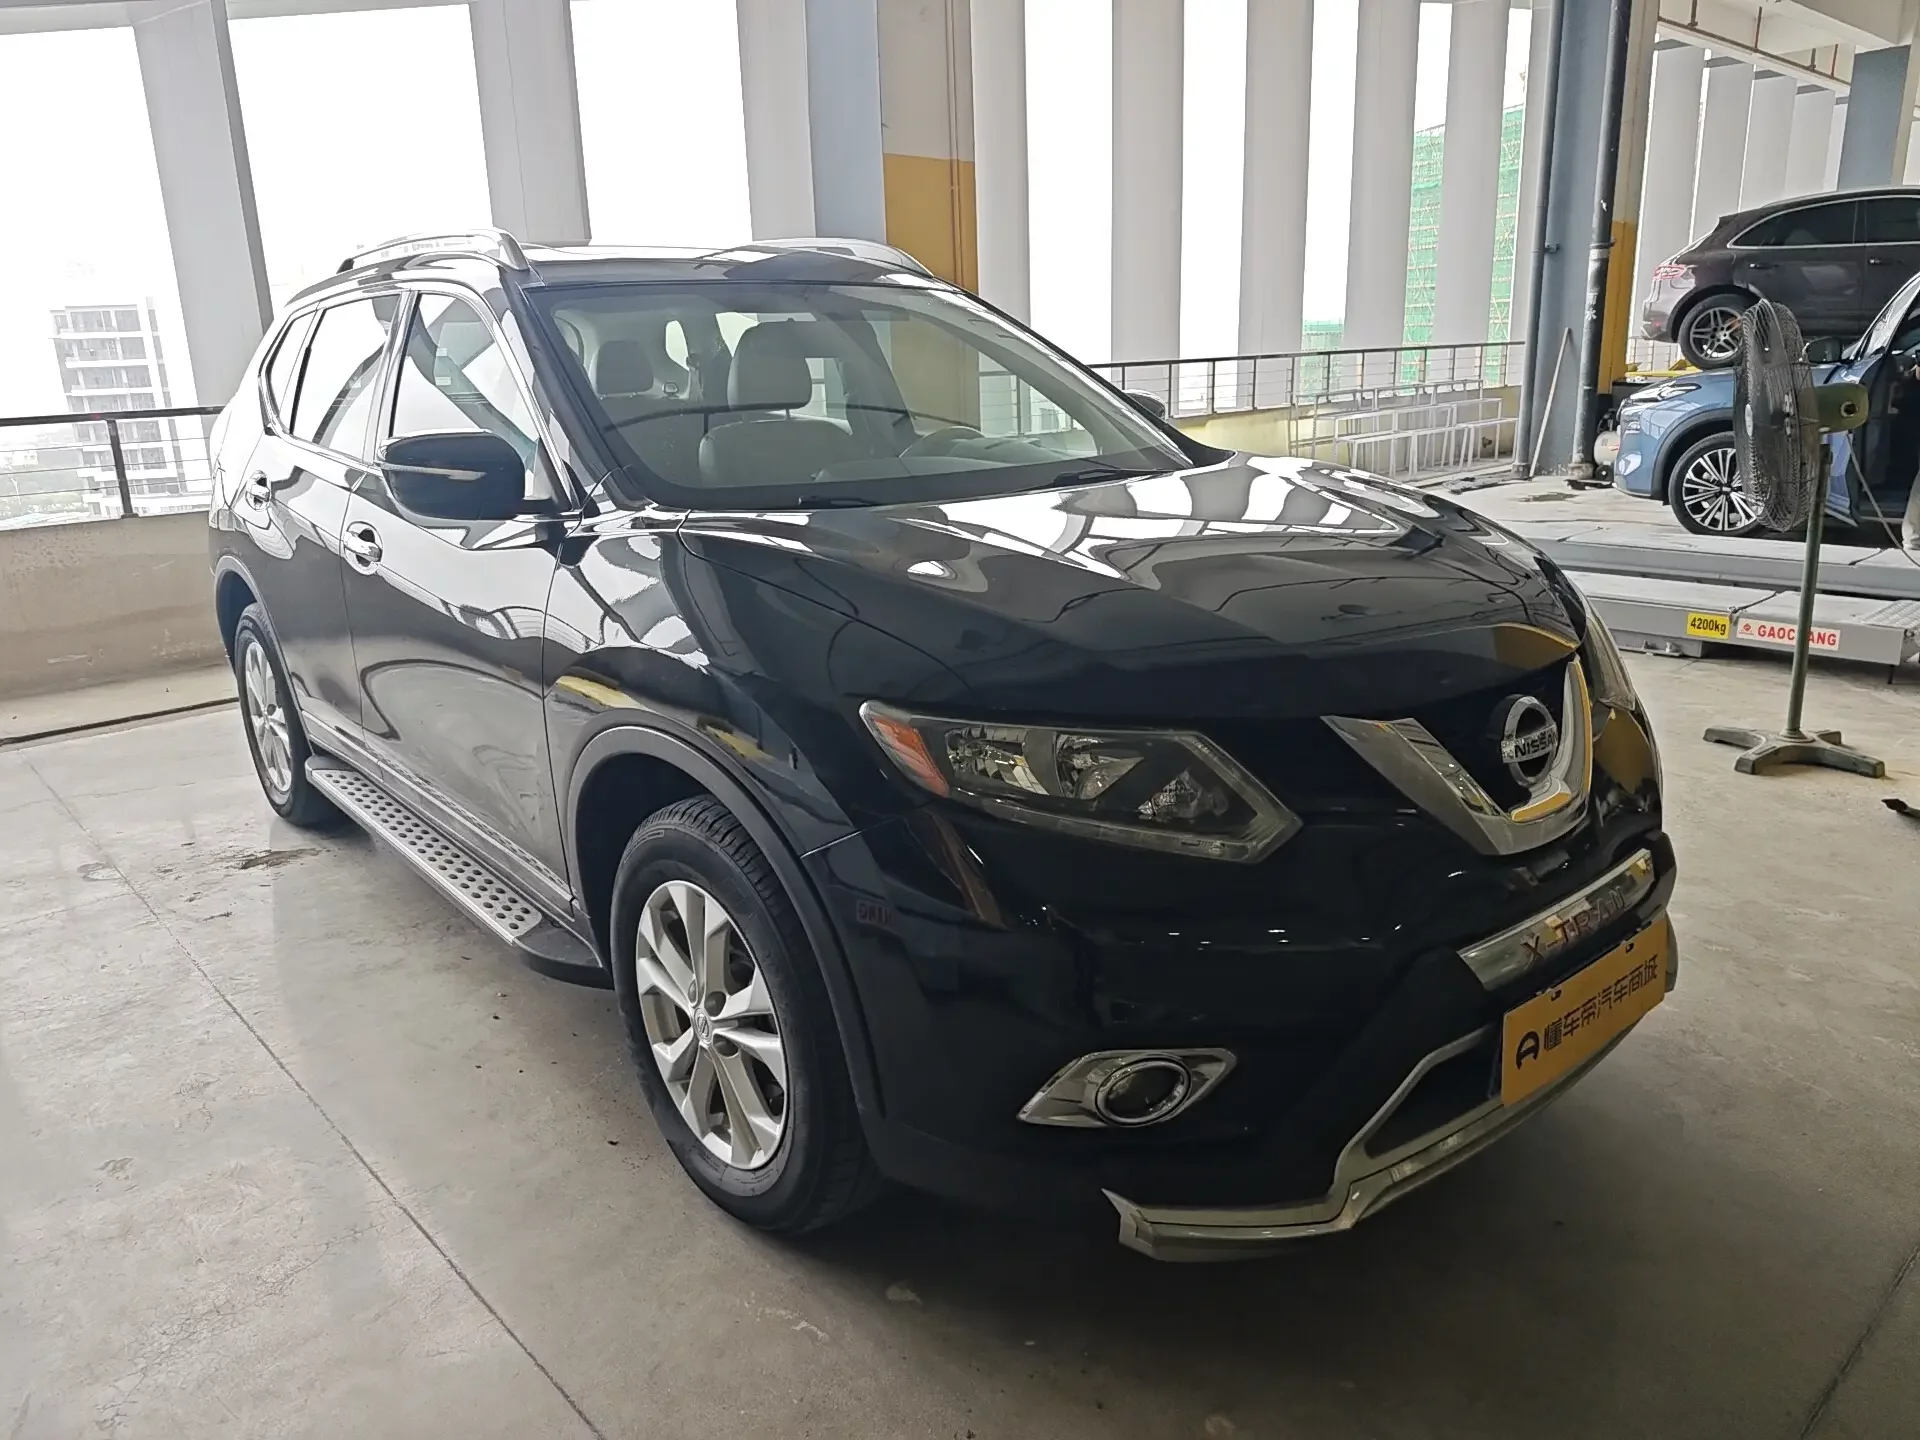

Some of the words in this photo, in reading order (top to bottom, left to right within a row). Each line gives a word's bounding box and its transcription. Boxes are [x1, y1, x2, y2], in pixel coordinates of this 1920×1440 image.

[1690, 617, 1726, 635] 4200kg
[1758, 624, 1836, 646] GAOCANG
[1514, 730, 1557, 758] NISSAN
[1543, 954, 1658, 1051] 懂车帝汽车商城
